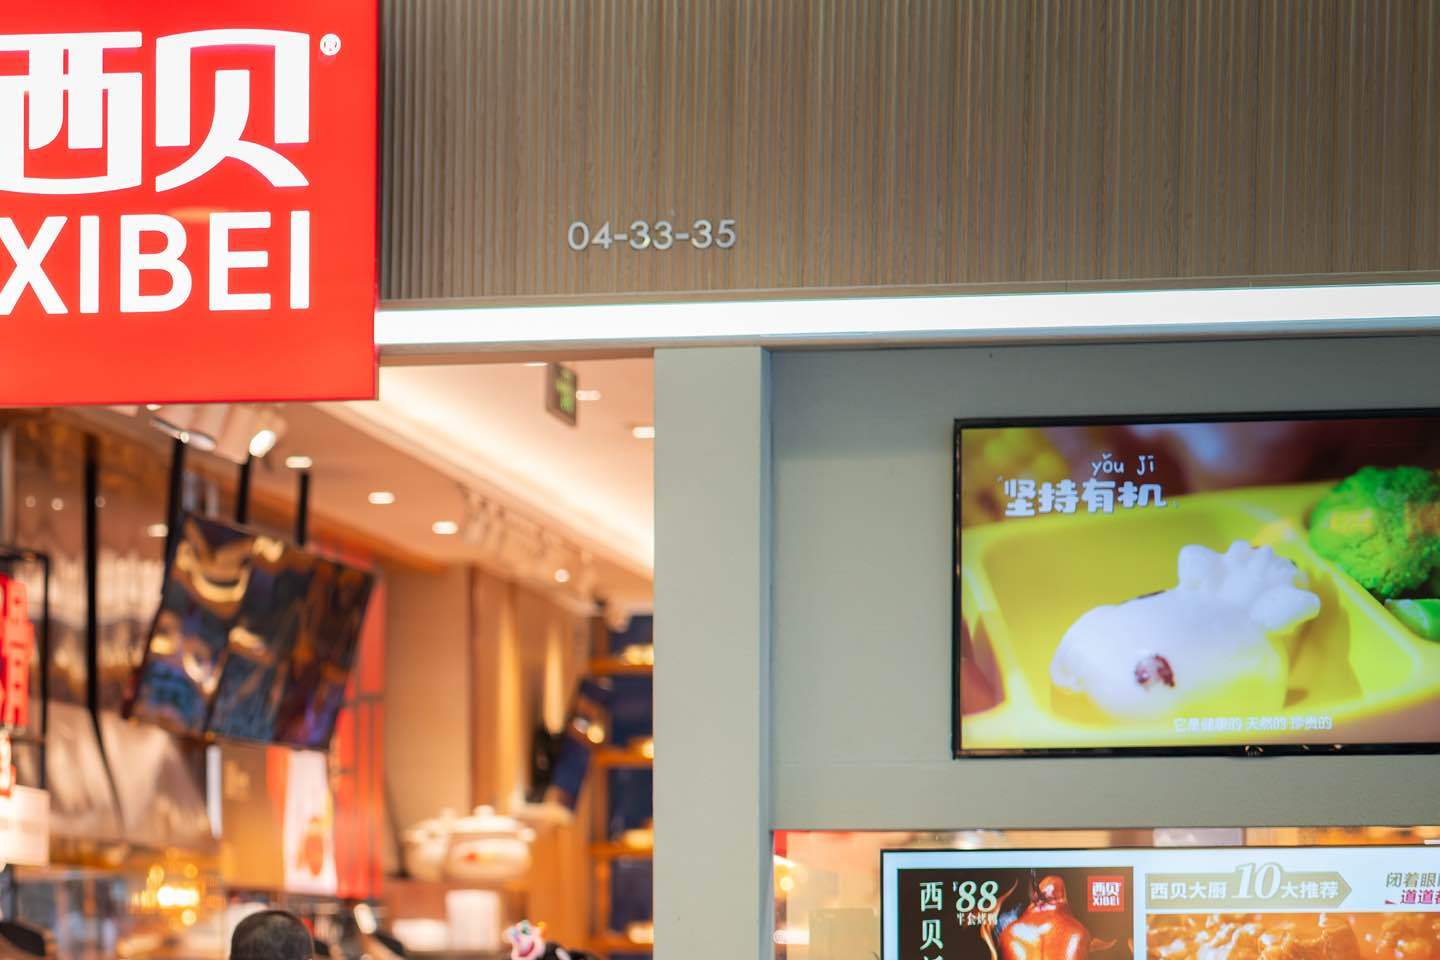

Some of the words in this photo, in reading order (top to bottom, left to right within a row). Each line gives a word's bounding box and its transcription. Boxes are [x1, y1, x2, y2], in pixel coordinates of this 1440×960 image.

[567, 219, 737, 250] 04-33-35
[1004, 477, 1168, 518] 坚持有机
[1385, 871, 1440, 888] 闭着眼
[1092, 882, 1121, 896] 西贝
[1400, 888, 1440, 905] 道道
